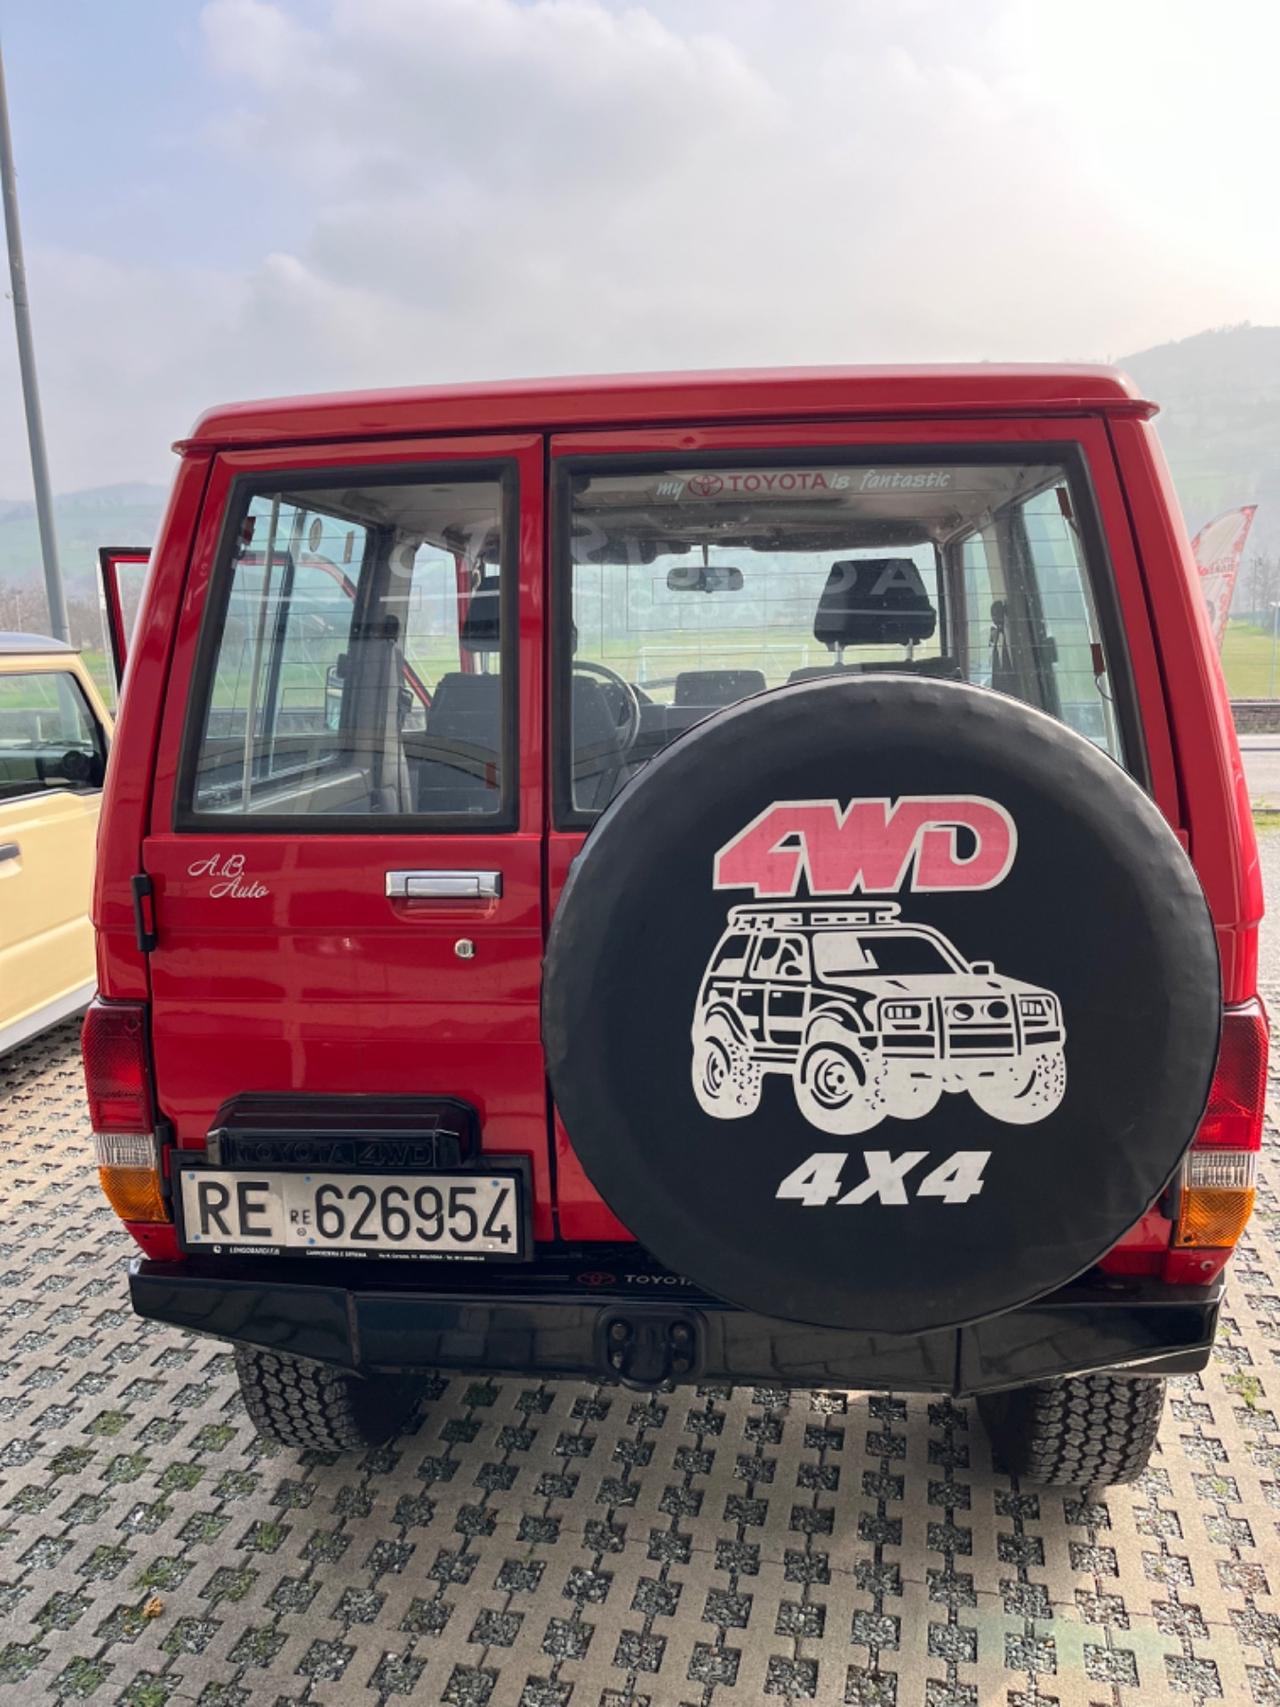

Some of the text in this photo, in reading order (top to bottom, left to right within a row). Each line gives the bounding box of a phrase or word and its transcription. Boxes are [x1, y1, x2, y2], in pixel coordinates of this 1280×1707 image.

[656, 469, 950, 500] my TOYOTA is fantastic
[713, 794, 1018, 898] 4WD
[209, 876, 270, 898] Auto
[237, 1141, 432, 1165] TOYOTA 4WD
[775, 1151, 992, 1206] 4X4
[198, 1181, 512, 1244] RE RE 626954
